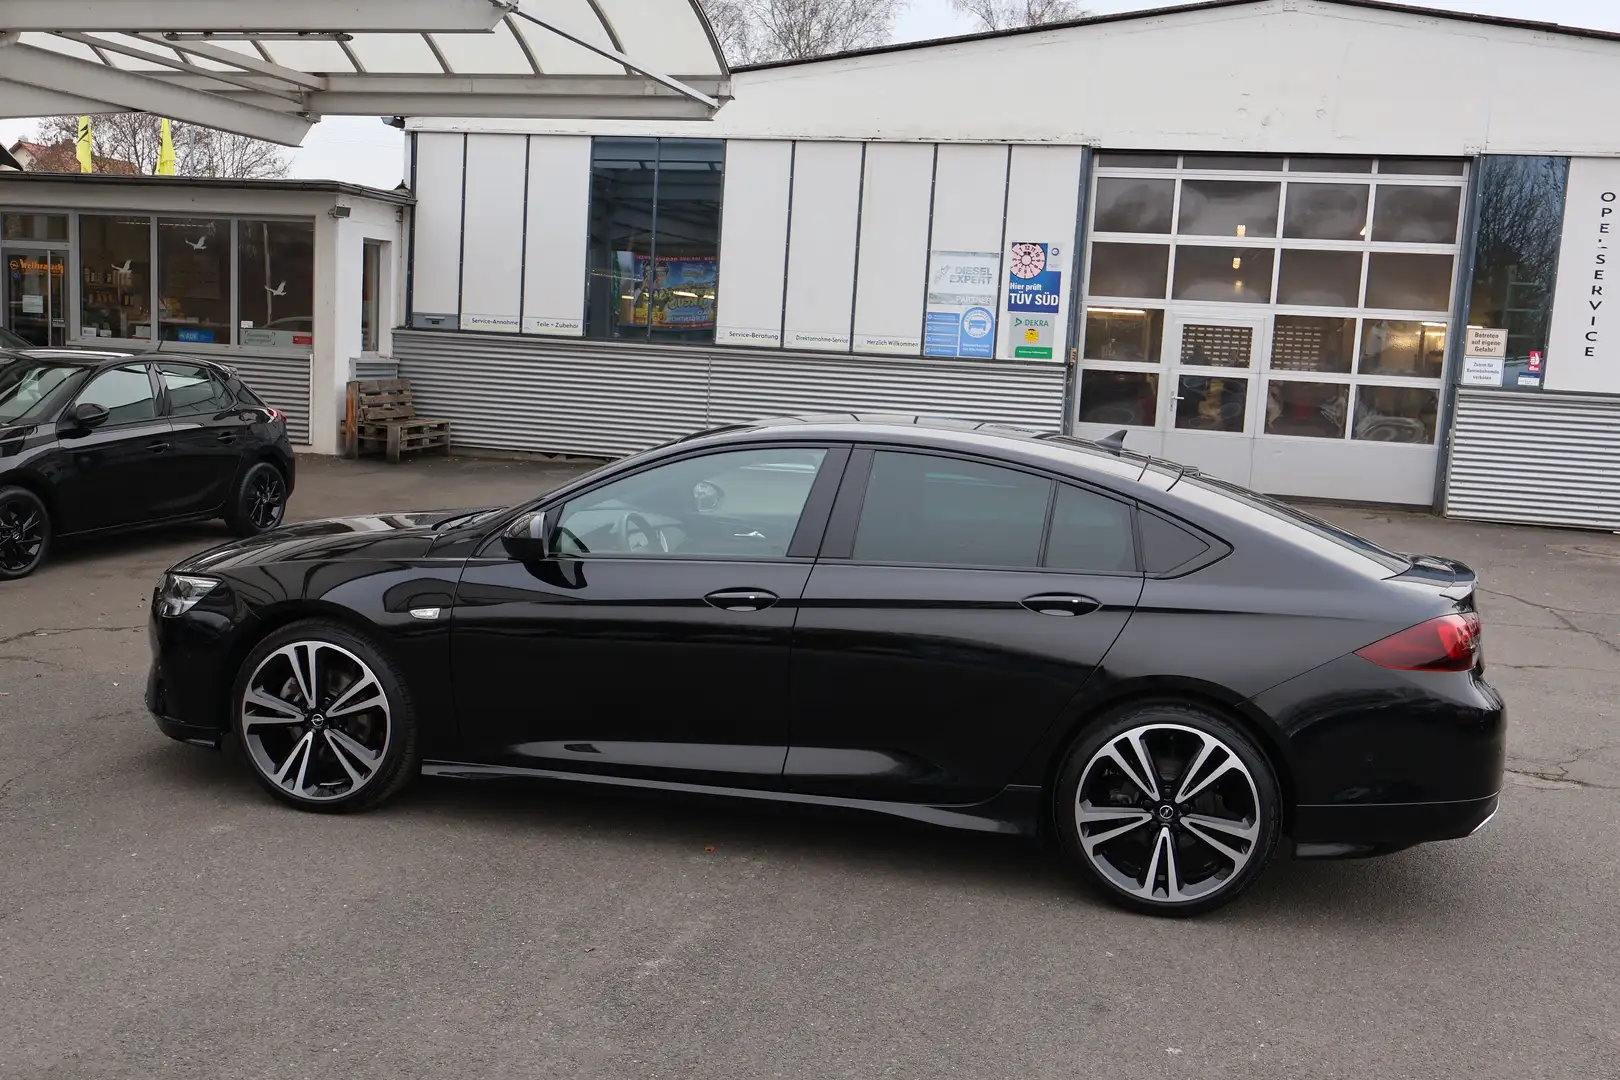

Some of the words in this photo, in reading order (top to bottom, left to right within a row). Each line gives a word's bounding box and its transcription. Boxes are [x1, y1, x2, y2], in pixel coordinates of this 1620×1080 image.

[955, 266, 993, 276] DIESEL
[949, 274, 993, 284] EXPERT
[1010, 282, 1024, 290] Hier
[1026, 283, 1042, 292] prüft
[1010, 290, 1032, 304] TÜV
[1034, 292, 1058, 306] SÜD
[1584, 254, 1606, 357] SERVICE
[472, 318, 518, 326] Service-Annahme
[1024, 318, 1048, 327] DEKRA
[728, 331, 778, 340] Service-Beratung
[796, 334, 848, 344] Direktannahme-Service
